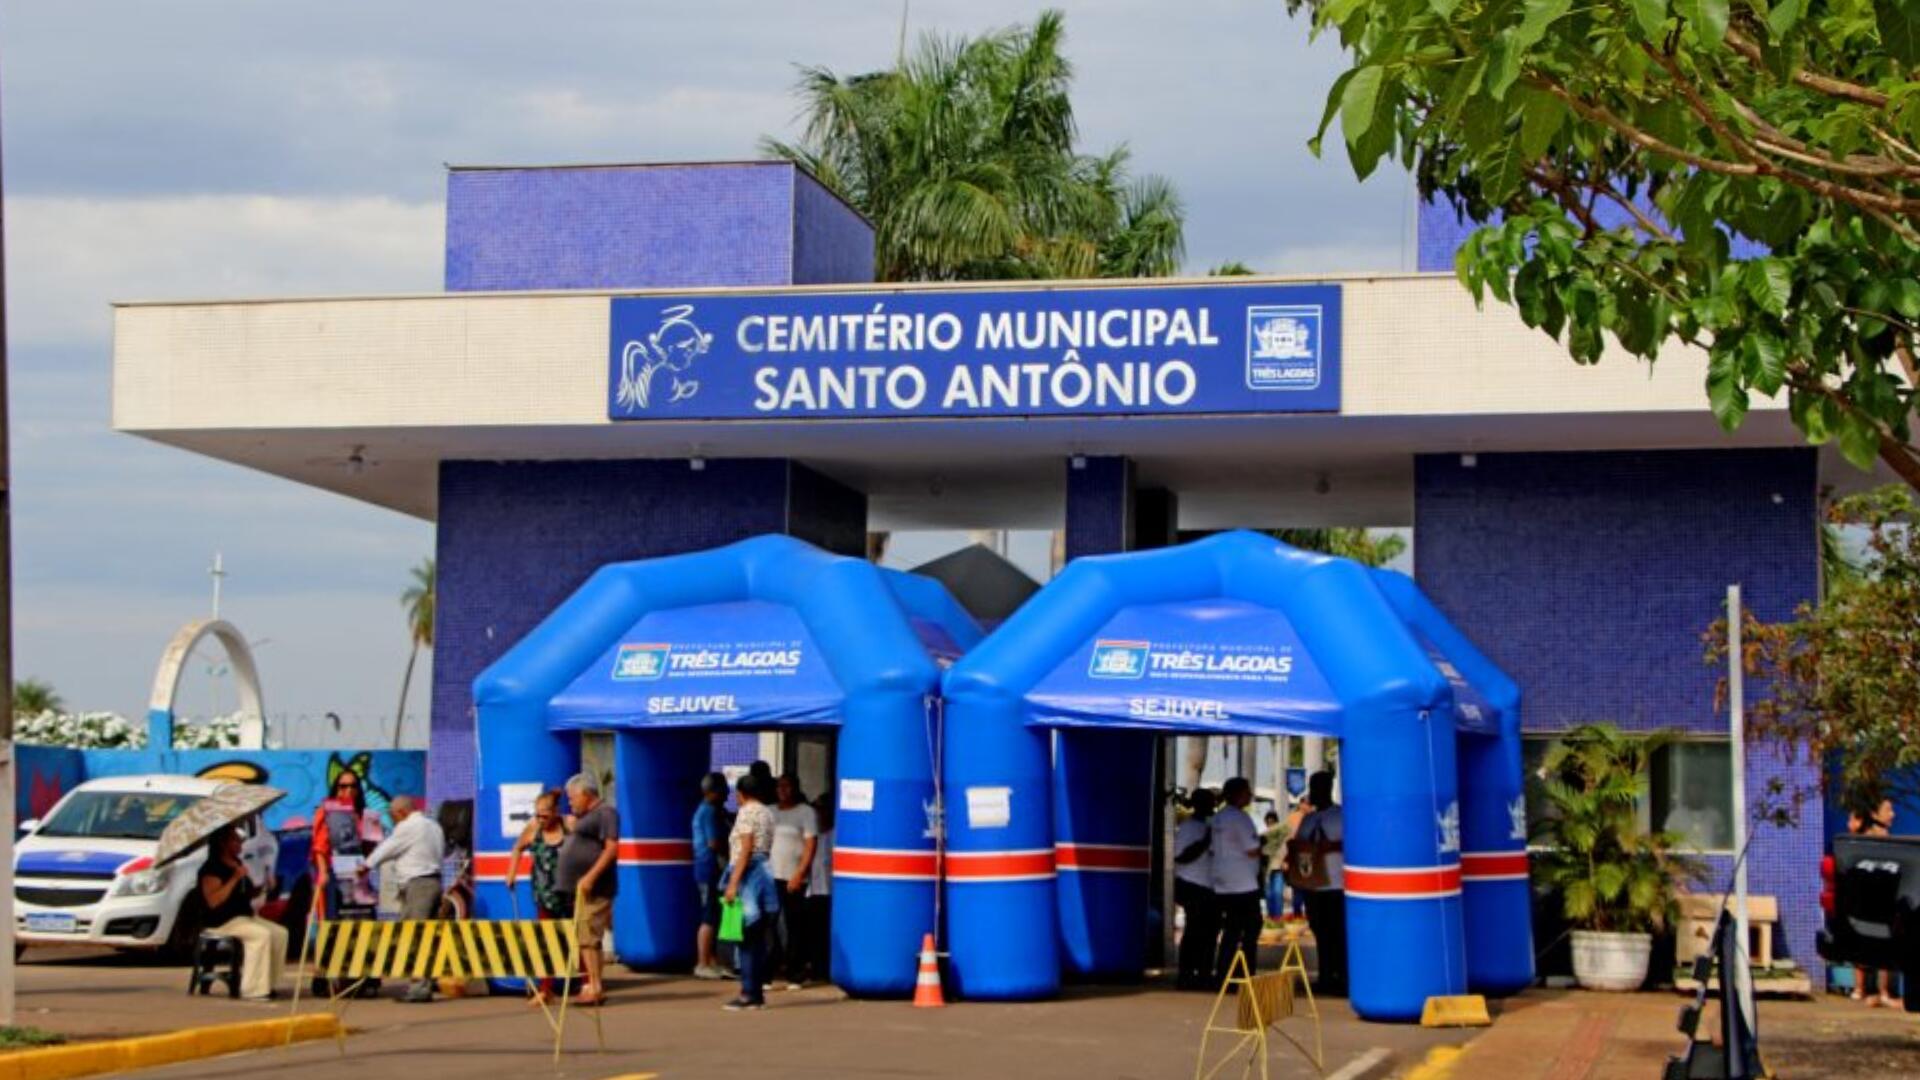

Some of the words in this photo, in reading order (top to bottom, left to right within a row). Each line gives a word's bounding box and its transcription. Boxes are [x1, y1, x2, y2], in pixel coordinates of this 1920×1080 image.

[736, 303, 962, 354] CEMITÉRIO
[975, 306, 1219, 350] MUNICIPAL
[753, 364, 927, 411] SANTO
[942, 347, 1197, 409] ANTÔNIO
[669, 649, 720, 669] TRÊS
[722, 650, 802, 668] LAGOAS
[1150, 649, 1204, 670] TRÊS
[1206, 654, 1293, 673] LAGOAS
[648, 695, 740, 713] SEJUVEL
[1129, 698, 1229, 719] SEJUVEL
